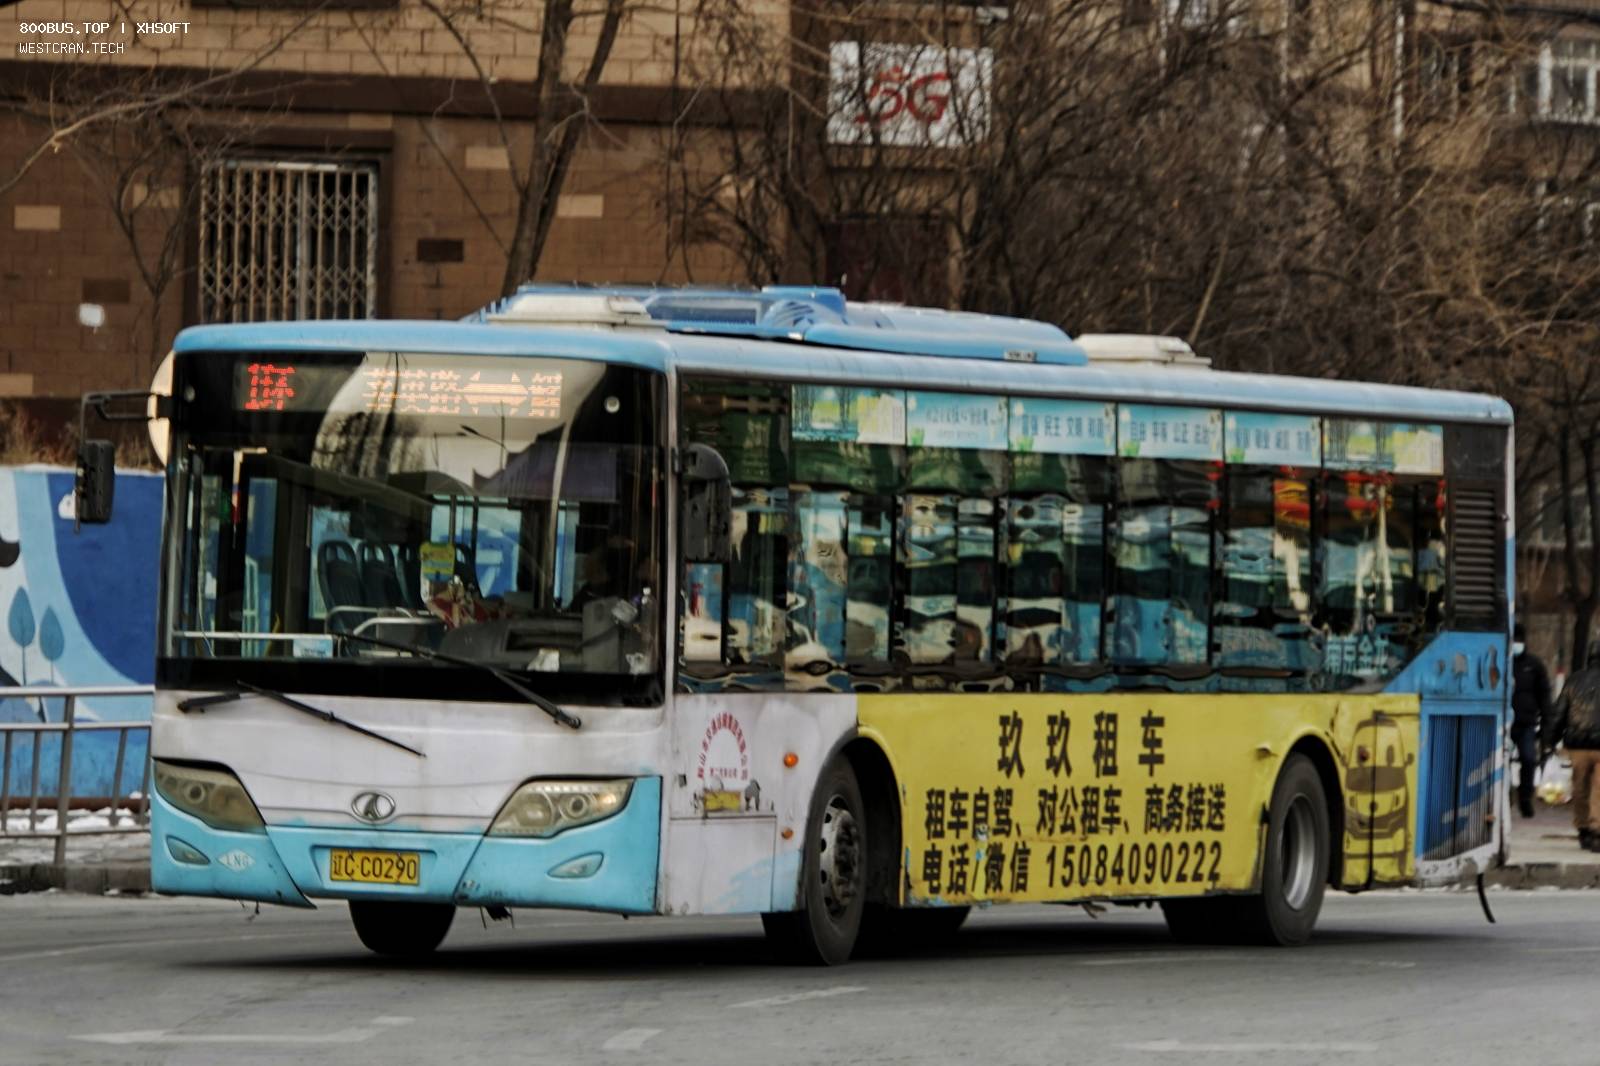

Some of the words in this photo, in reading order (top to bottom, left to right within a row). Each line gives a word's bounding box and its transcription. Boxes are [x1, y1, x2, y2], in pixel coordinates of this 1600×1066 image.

[854, 65, 951, 123] 5G
[998, 710, 1165, 778] 玖玖租车
[923, 841, 1031, 895] 电话/微信
[1046, 841, 1222, 889] 15084090222
